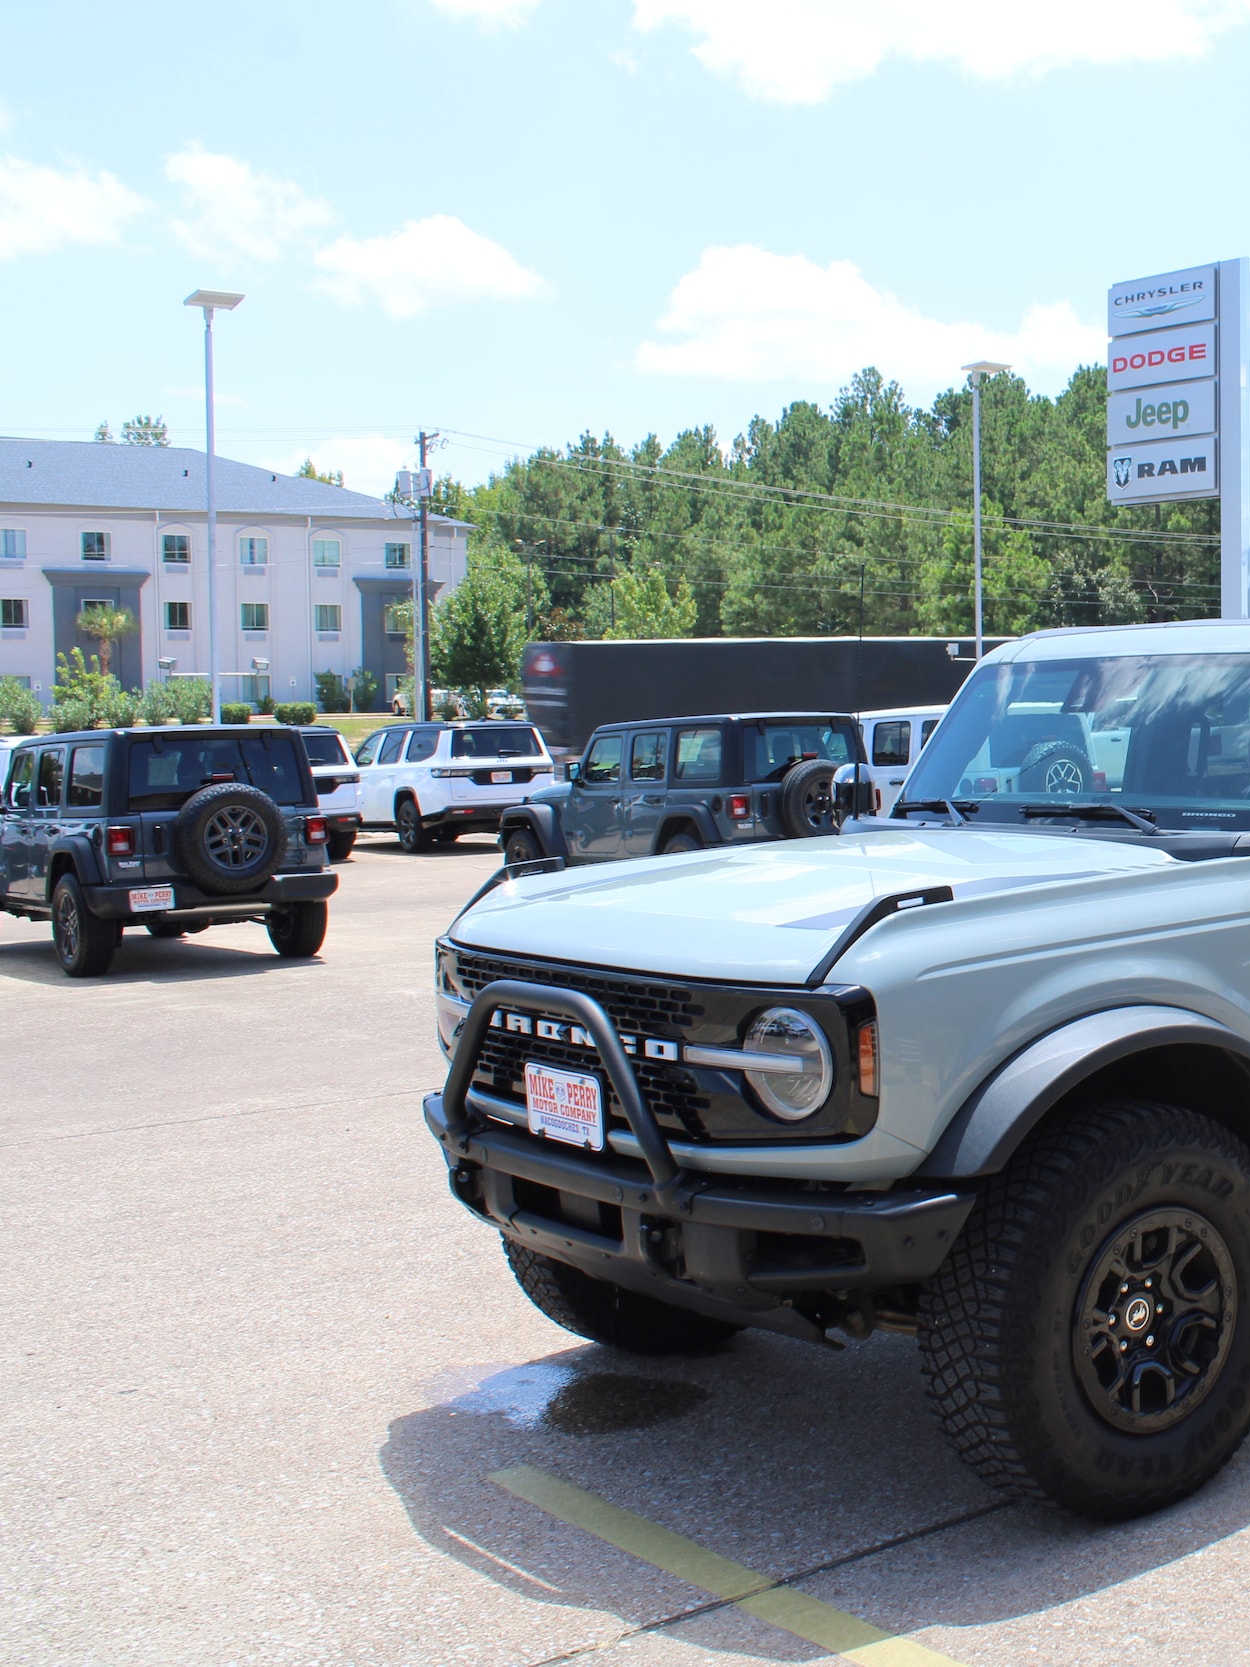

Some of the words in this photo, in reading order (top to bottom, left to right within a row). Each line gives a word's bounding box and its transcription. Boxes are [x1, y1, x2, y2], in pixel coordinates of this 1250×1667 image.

[1114, 281, 1204, 306] CHRYSLER
[1112, 343, 1207, 373] DODGE
[1125, 398, 1190, 429] Jeep
[1137, 456, 1207, 479] RAM
[131, 892, 148, 900] MIKE
[529, 1073, 556, 1100] MIKE
[566, 1082, 597, 1111] PERRY
[532, 1097, 558, 1114] MOTOR
[560, 1104, 597, 1124] COMPANY
